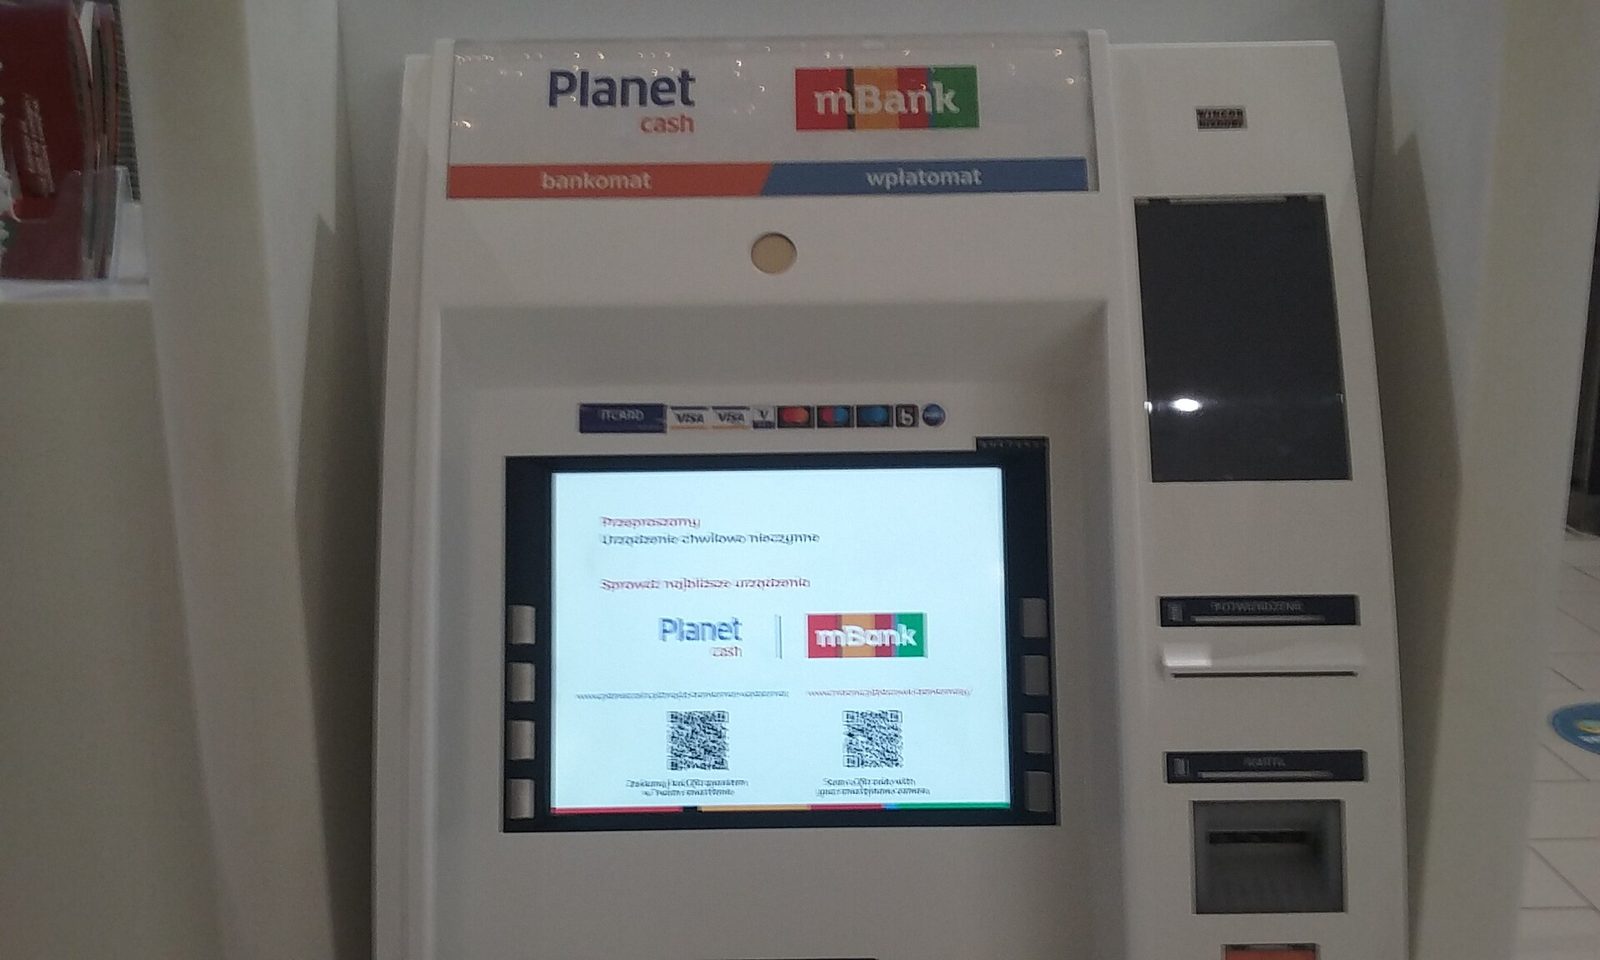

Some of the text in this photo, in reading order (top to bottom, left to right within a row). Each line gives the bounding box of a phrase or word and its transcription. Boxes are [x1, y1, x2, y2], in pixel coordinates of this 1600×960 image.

[549, 69, 696, 108] Planet
[814, 82, 960, 115] mBank
[640, 113, 694, 134] cash
[541, 171, 652, 191] bankomat
[675, 411, 705, 424] VISA
[717, 411, 746, 424] VISA
[660, 617, 743, 642] Planet
[815, 624, 917, 648] mBank
[711, 645, 743, 657] cash
